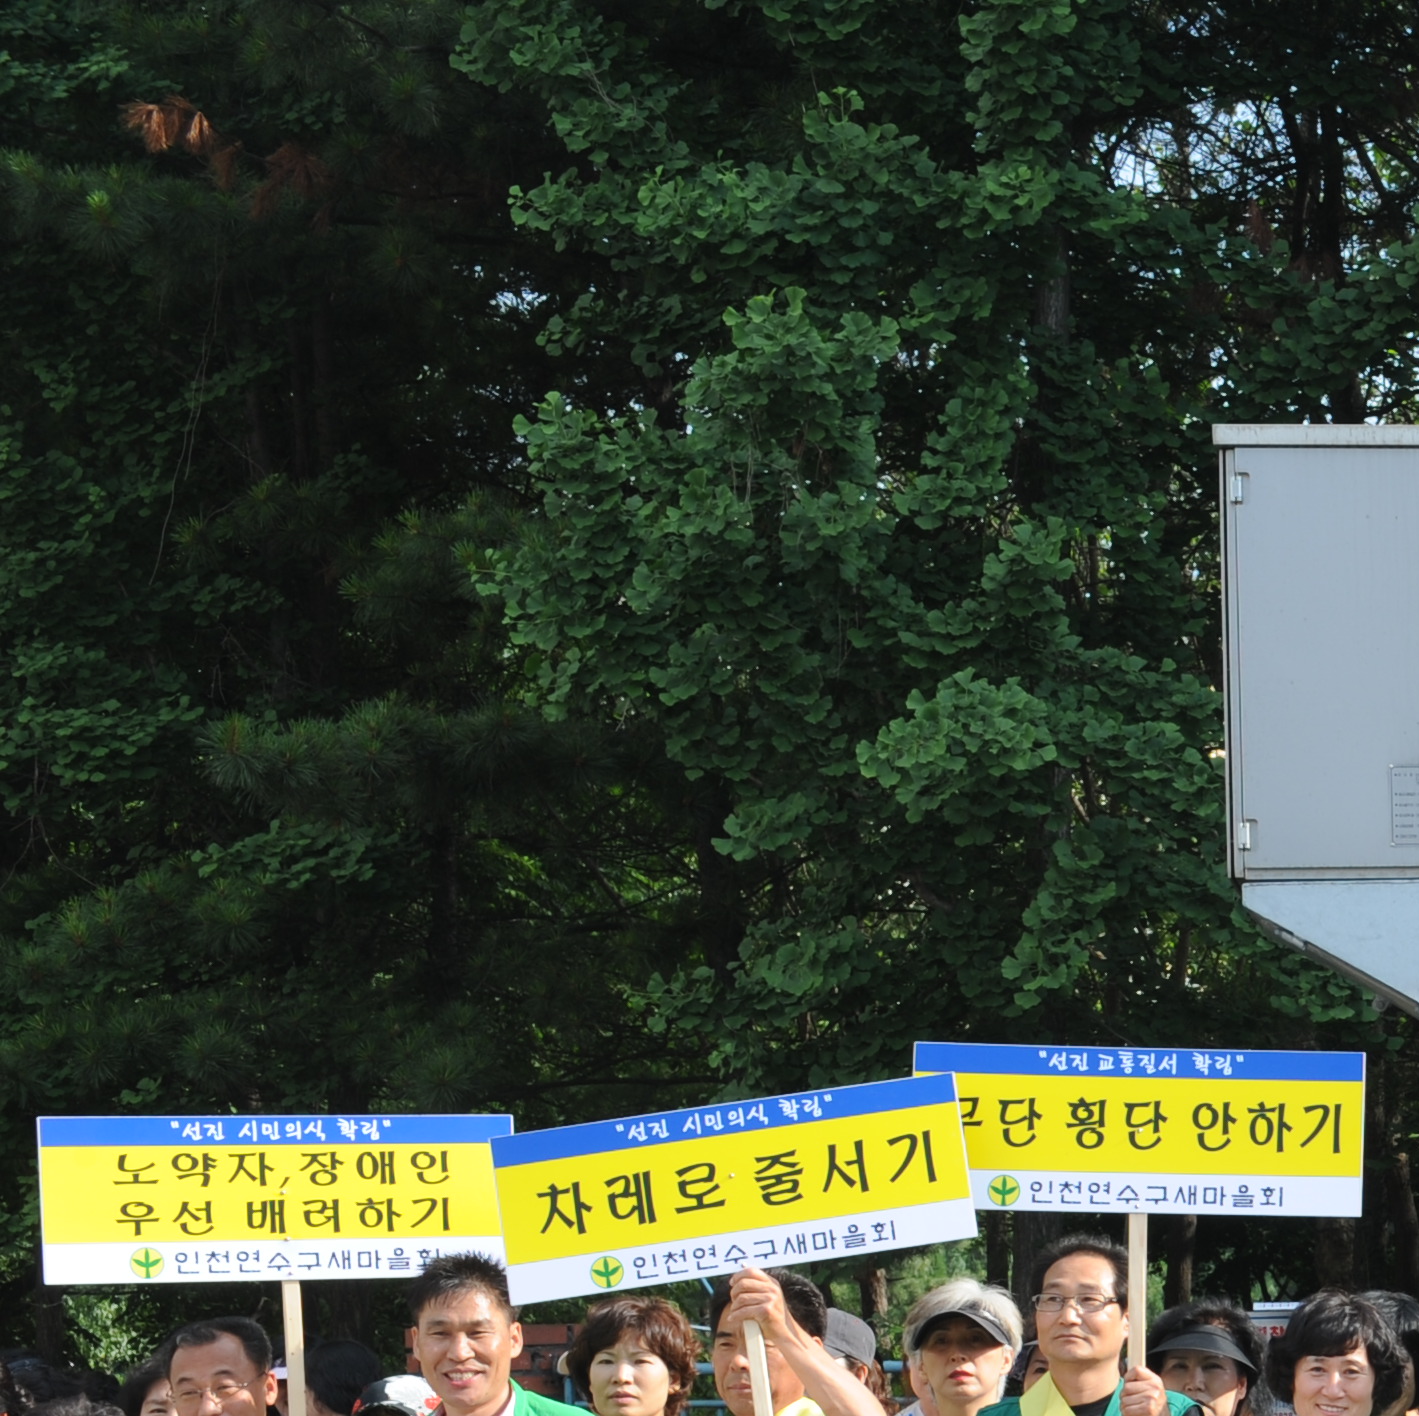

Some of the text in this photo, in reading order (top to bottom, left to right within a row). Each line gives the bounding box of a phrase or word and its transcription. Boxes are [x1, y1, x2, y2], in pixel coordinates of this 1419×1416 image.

[1097, 1051, 1178, 1076] 교통질서
[238, 1119, 327, 1142] 시민의식
[682, 1106, 769, 1136] 시민의식
[1065, 1096, 1169, 1151] 횡단
[1191, 1101, 1342, 1154] 안하기
[112, 1150, 451, 1189] 노약자,장애인
[537, 1129, 938, 1235] 차례로 줄서기
[1029, 1180, 1285, 1208] 인천연수구새마을회
[115, 1197, 451, 1237] 우선 배려하기
[632, 1219, 898, 1281] 인천연수구새마을회
